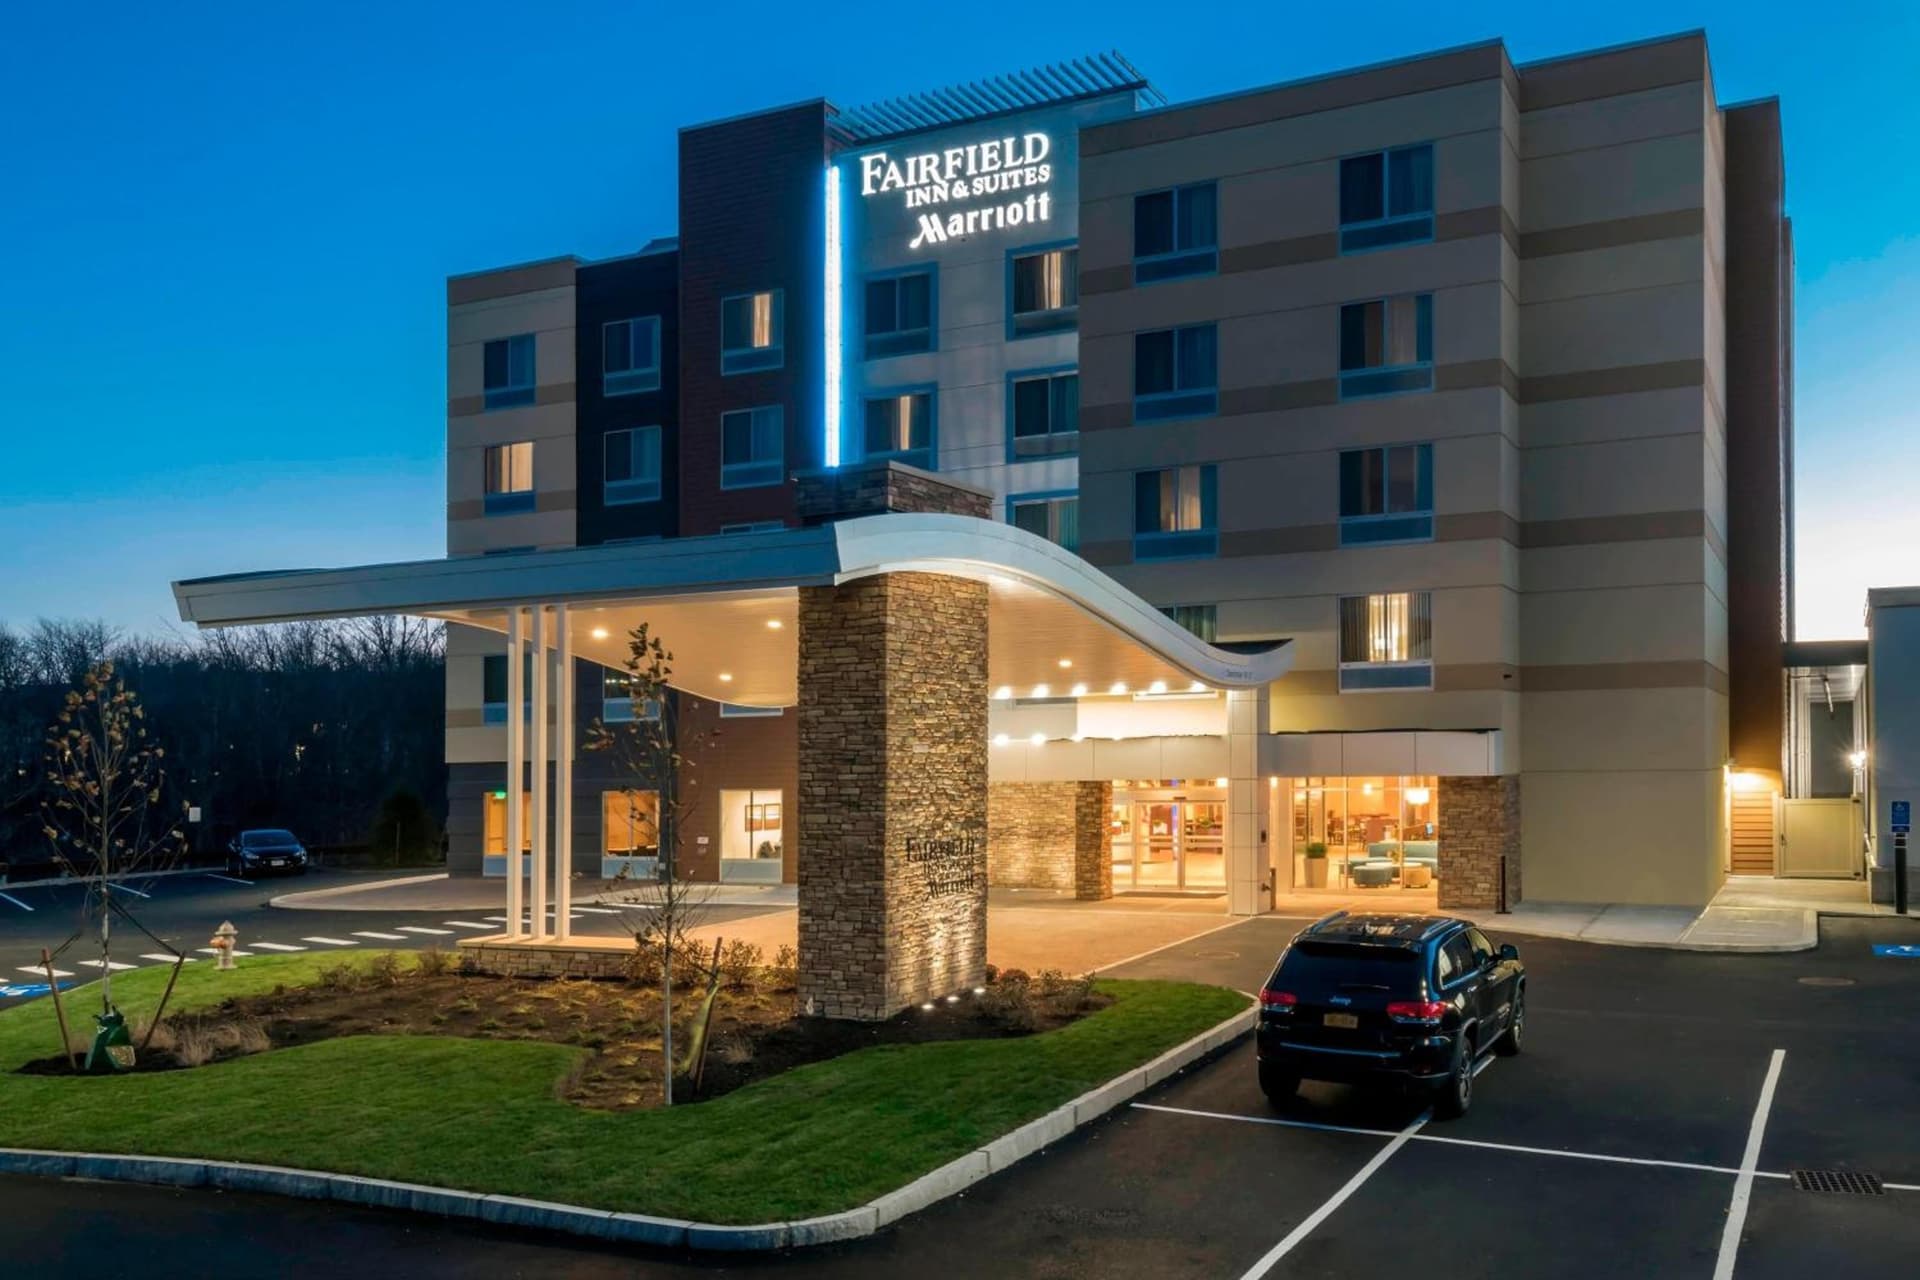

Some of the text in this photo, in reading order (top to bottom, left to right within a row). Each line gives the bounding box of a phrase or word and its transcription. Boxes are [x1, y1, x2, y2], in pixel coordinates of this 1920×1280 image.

[860, 132, 1050, 197] FAIRFIELD
[906, 164, 1051, 208] INN & SUITES
[909, 191, 1051, 249] Marriott
